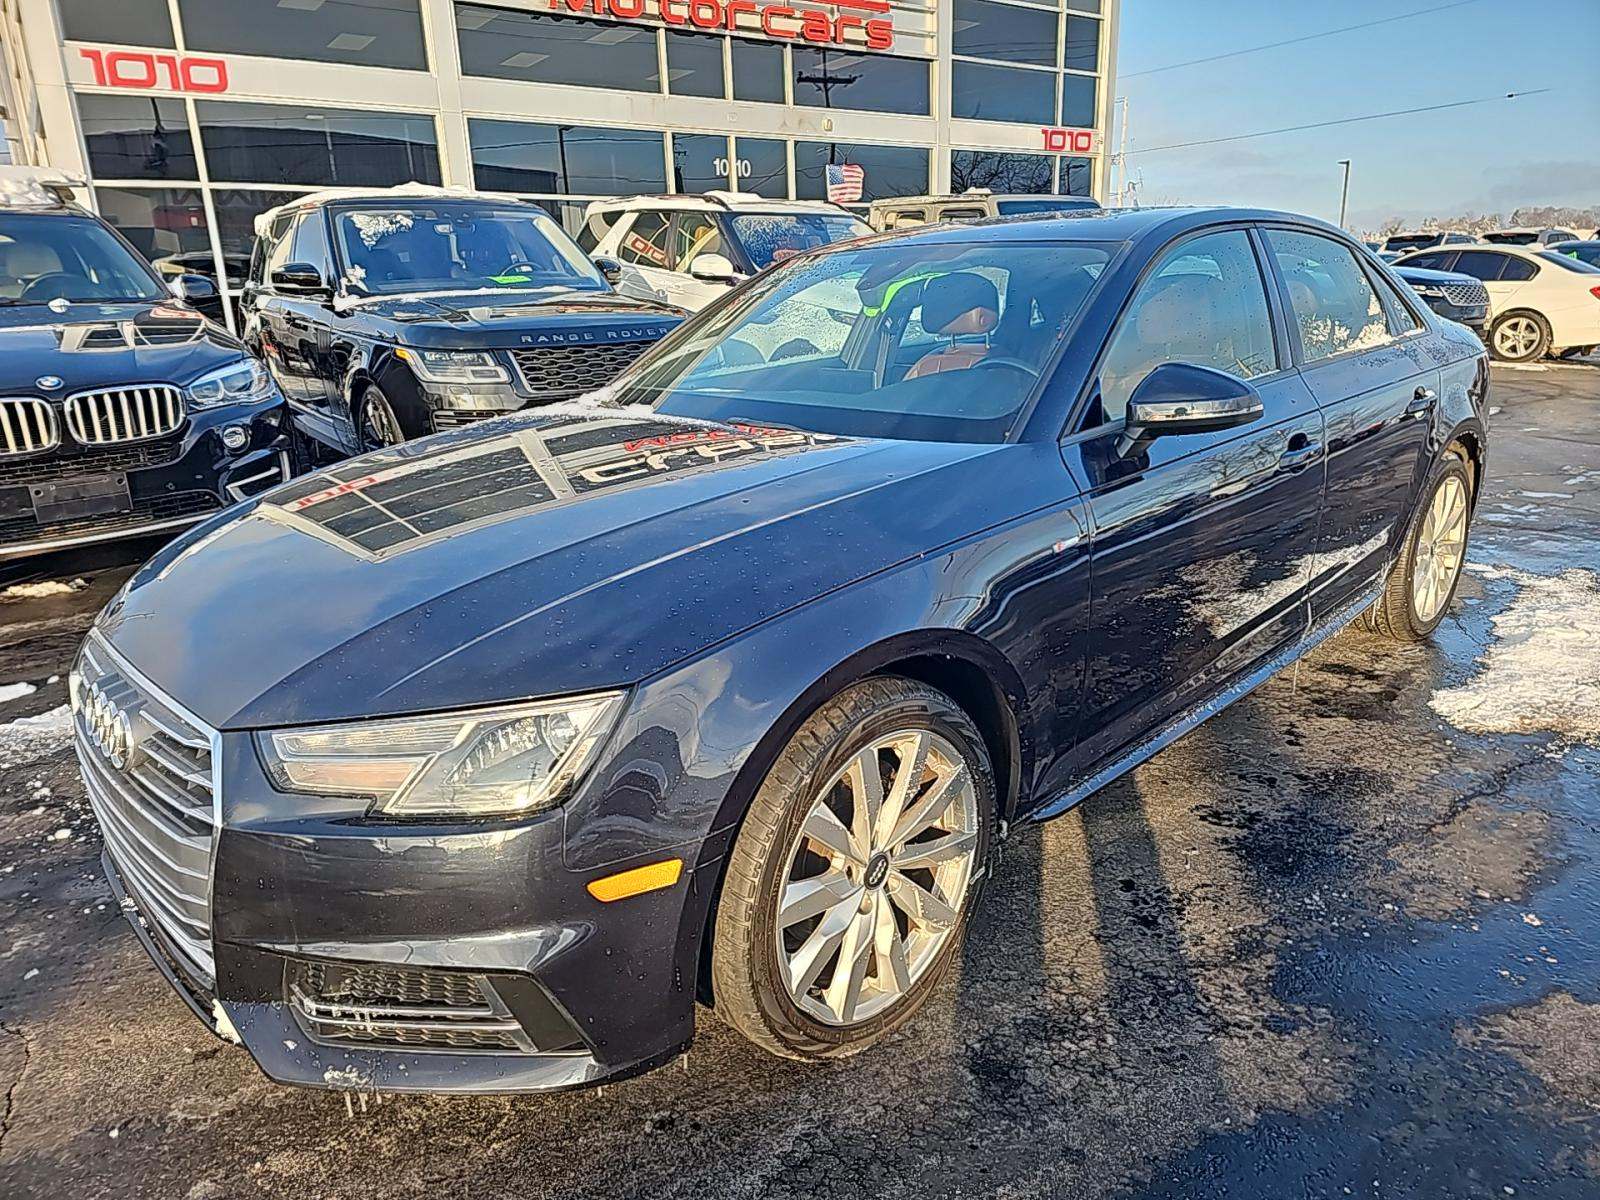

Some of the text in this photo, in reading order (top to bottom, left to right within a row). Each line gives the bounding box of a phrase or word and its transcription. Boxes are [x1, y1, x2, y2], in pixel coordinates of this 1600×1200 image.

[79, 48, 229, 94] 1010
[1041, 128, 1092, 152] 1010
[520, 327, 668, 343] RANGE ROVER
